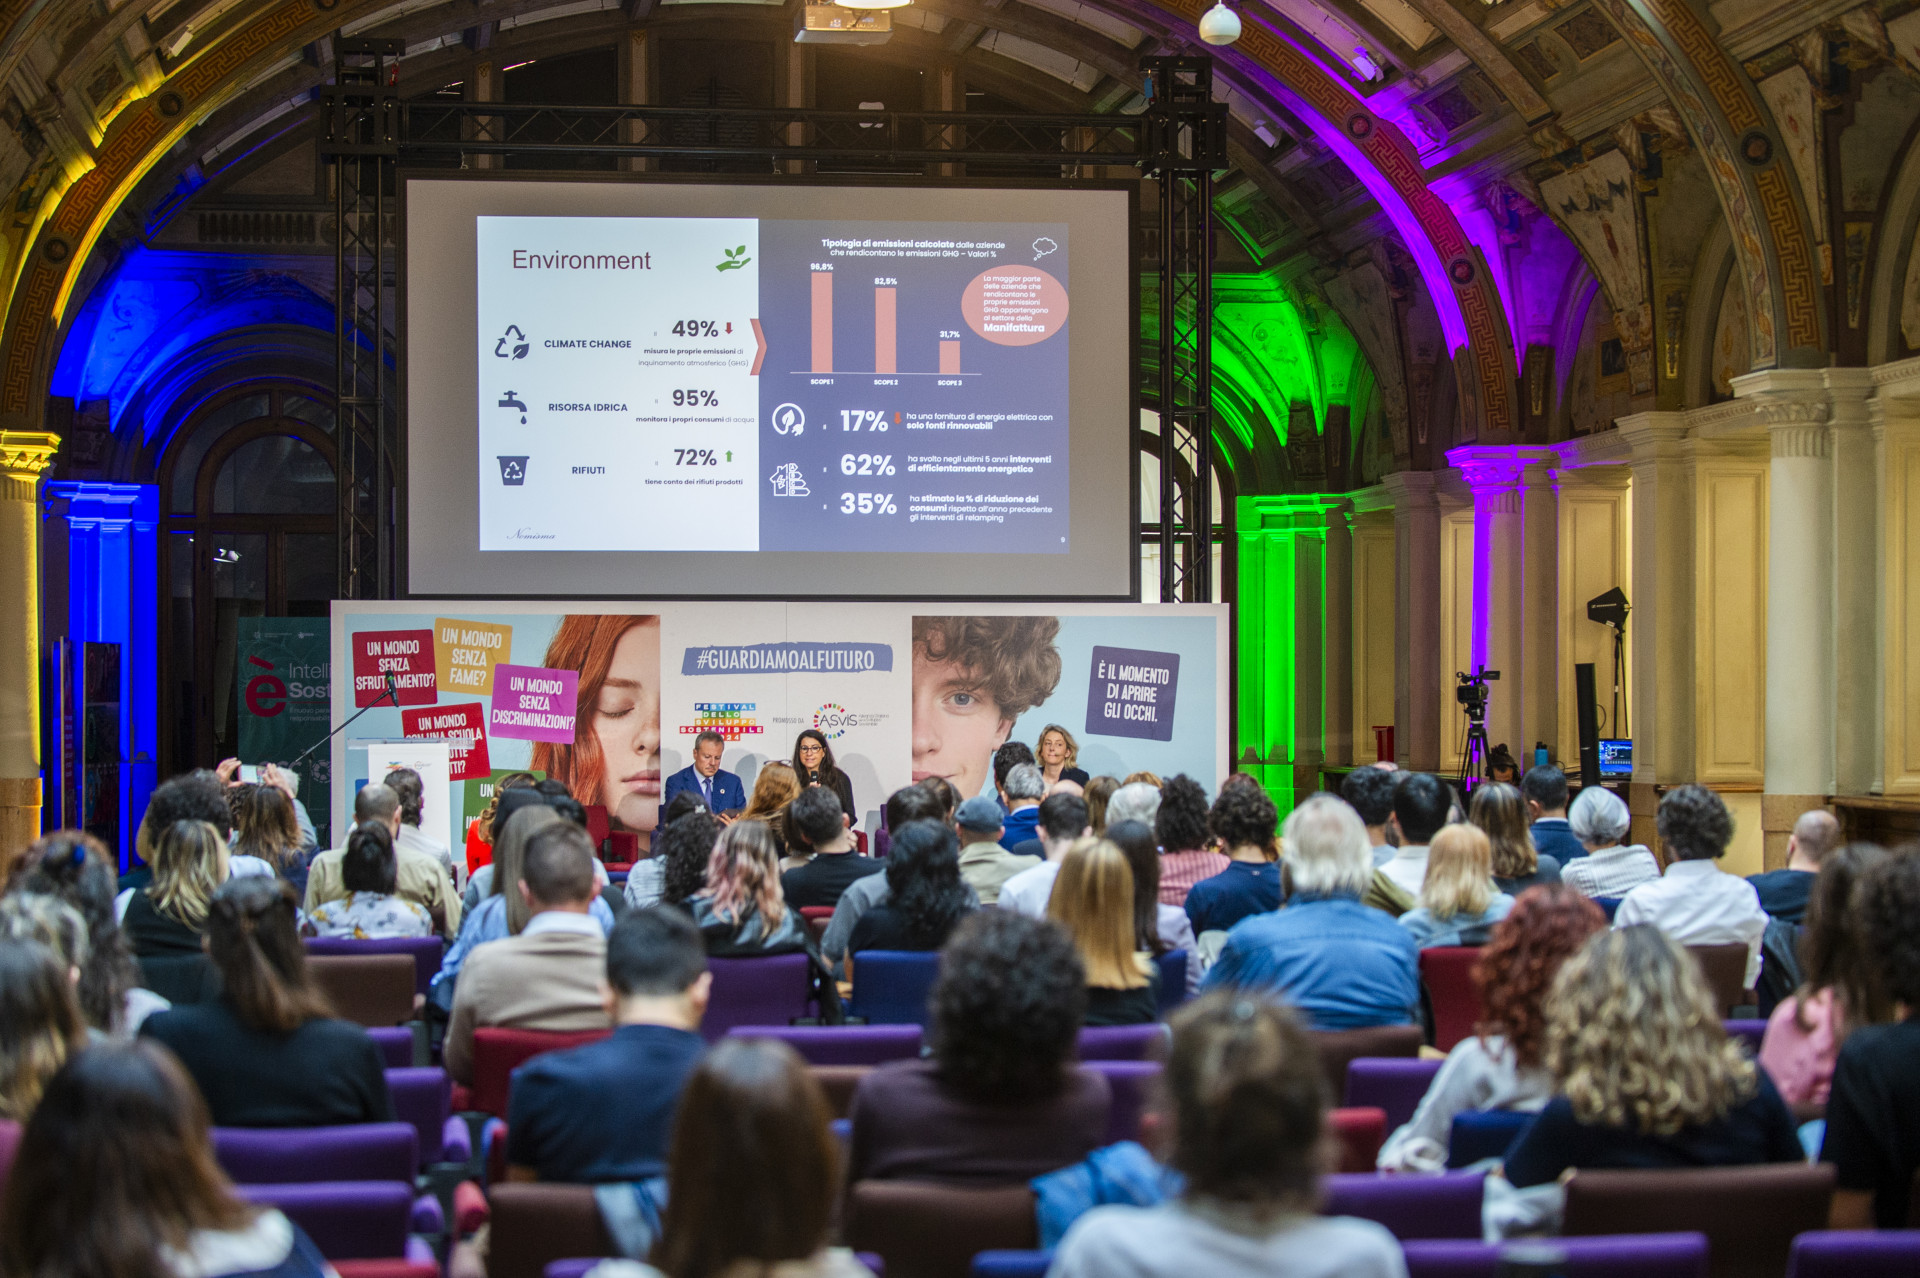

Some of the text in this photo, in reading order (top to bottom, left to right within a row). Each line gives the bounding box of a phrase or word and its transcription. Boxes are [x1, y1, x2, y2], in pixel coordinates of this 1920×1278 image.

[822, 239, 861, 249] Tipologia
[863, 239, 871, 248] di
[872, 240, 913, 248] emissioni
[914, 240, 954, 248] calcolate
[512, 250, 651, 270] Environment
[672, 320, 718, 337] 49%
[984, 323, 1045, 332] Manifattura
[544, 340, 632, 349] CLIMATE CHANGE
[672, 389, 718, 406] 95%
[549, 403, 628, 412] RISORSA IDRICA
[840, 410, 889, 432] 17%
[976, 413, 1005, 422] energia
[674, 449, 717, 466] 72%
[841, 454, 896, 476] 62%
[943, 456, 961, 464] negli
[572, 466, 605, 474] RIFIUTI
[918, 464, 986, 472] efficientamento
[987, 465, 1034, 474] energetico
[840, 492, 897, 514] 35%
[921, 494, 955, 503] stimato
[984, 495, 1024, 503] riduzione
[948, 504, 977, 514] rispetto
[1009, 506, 1053, 514] precedente
[910, 513, 919, 522] gli
[965, 514, 1004, 523] relamping
[506, 527, 556, 539] Nomisma
[442, 628, 502, 649] UN MONDO
[367, 640, 419, 656] UN MONDO
[378, 658, 410, 672] SENZA
[452, 648, 487, 667] SENZA
[697, 650, 875, 670] #GUARDIAMOALFUTURO
[449, 668, 487, 687] FAME?
[1098, 660, 1169, 685] È IL MOMENTO
[245, 655, 287, 718] è
[356, 673, 435, 690] SFRUTMENTO?
[510, 677, 563, 695] UN MONDO
[1107, 683, 1157, 703] DI APRIRE
[519, 695, 550, 711] SENZA
[492, 709, 576, 730] DISCRIMINAZIONI?
[1104, 702, 1158, 722] GLI OCCHI.
[418, 713, 467, 730] UN MONDO
[480, 784, 494, 797] UN
